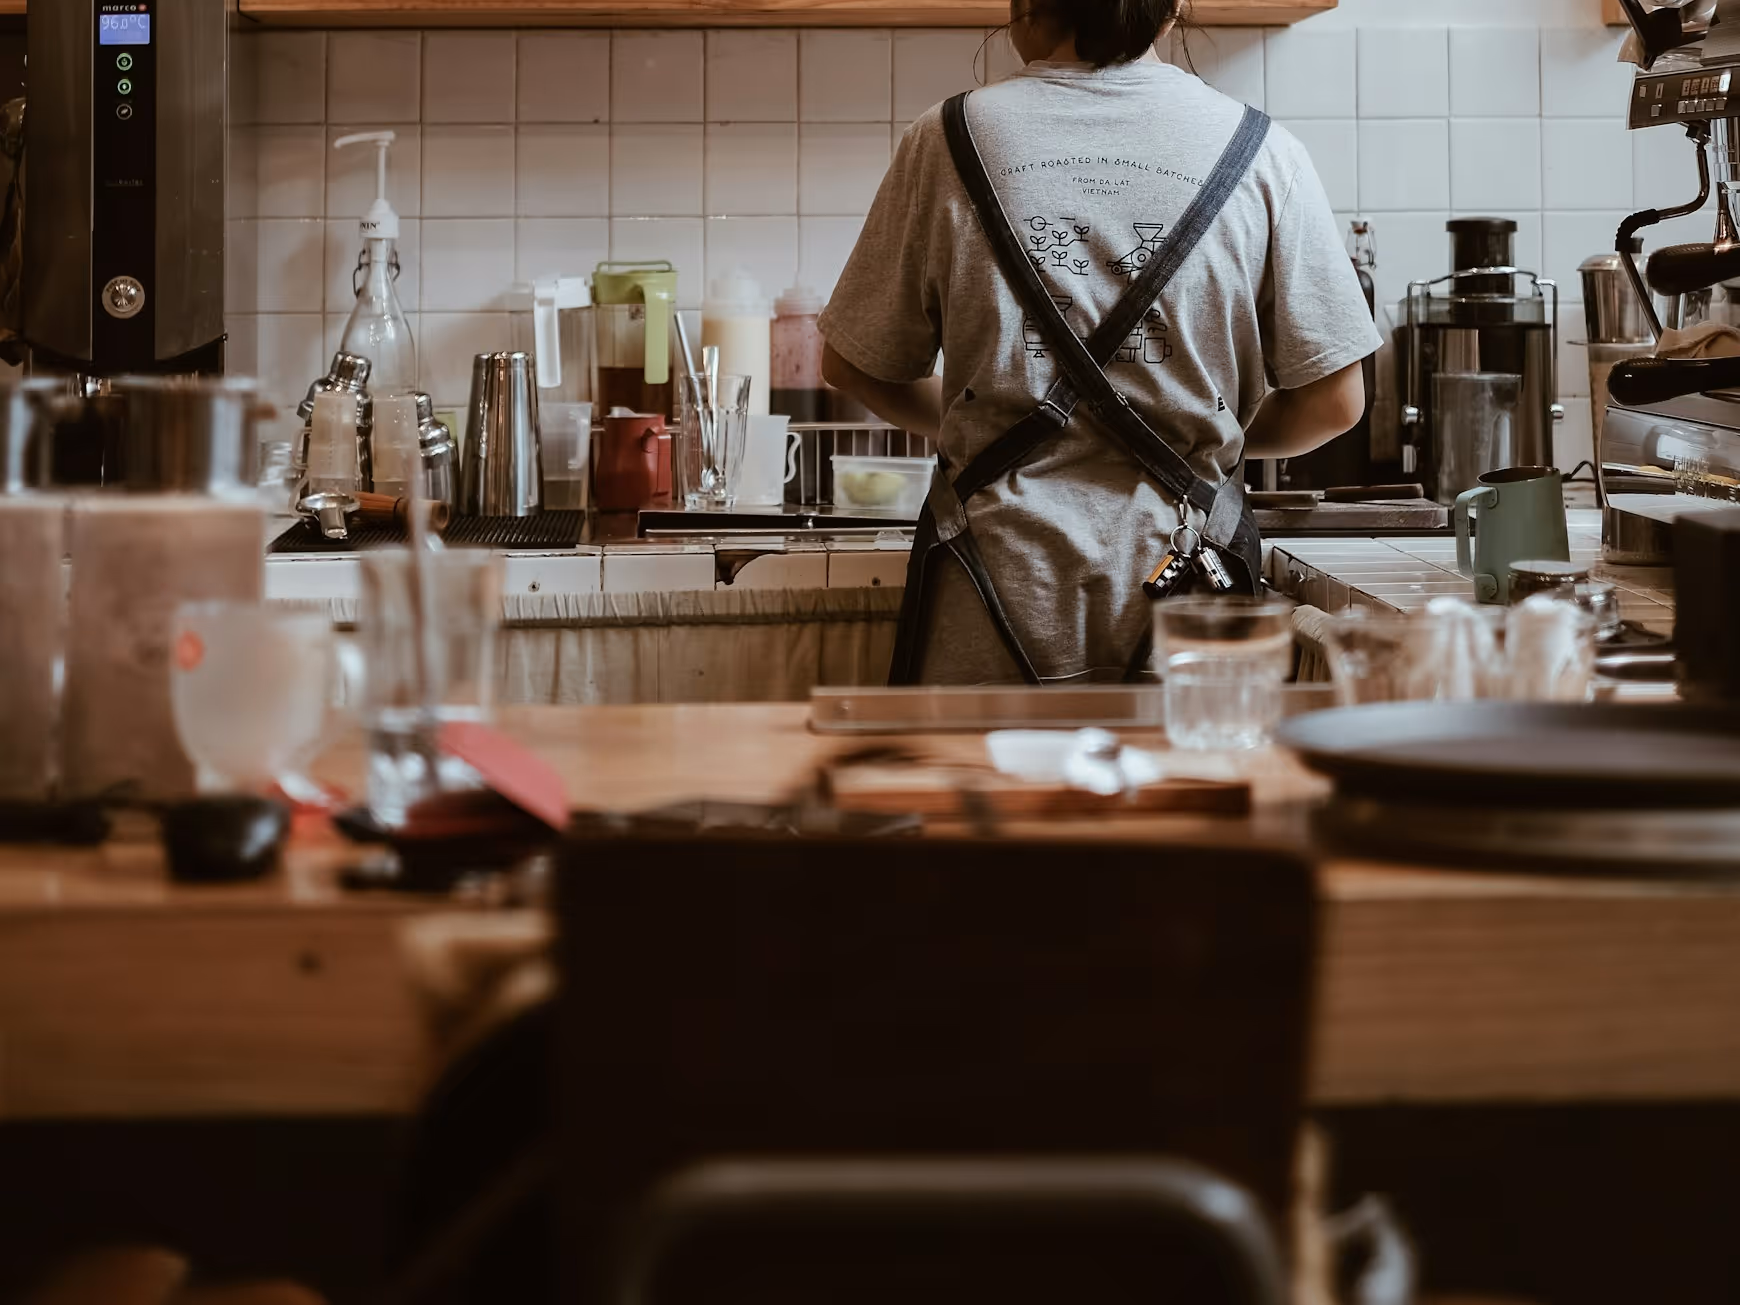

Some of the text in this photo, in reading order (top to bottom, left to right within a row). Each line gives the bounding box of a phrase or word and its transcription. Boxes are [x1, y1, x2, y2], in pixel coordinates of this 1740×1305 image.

[102, 4, 137, 12] marco
[1000, 163, 1034, 176] CRAFT
[1041, 157, 1091, 169] ROASTED
[1114, 158, 1150, 171] SMALL
[1082, 188, 1120, 196] VIETNAM
